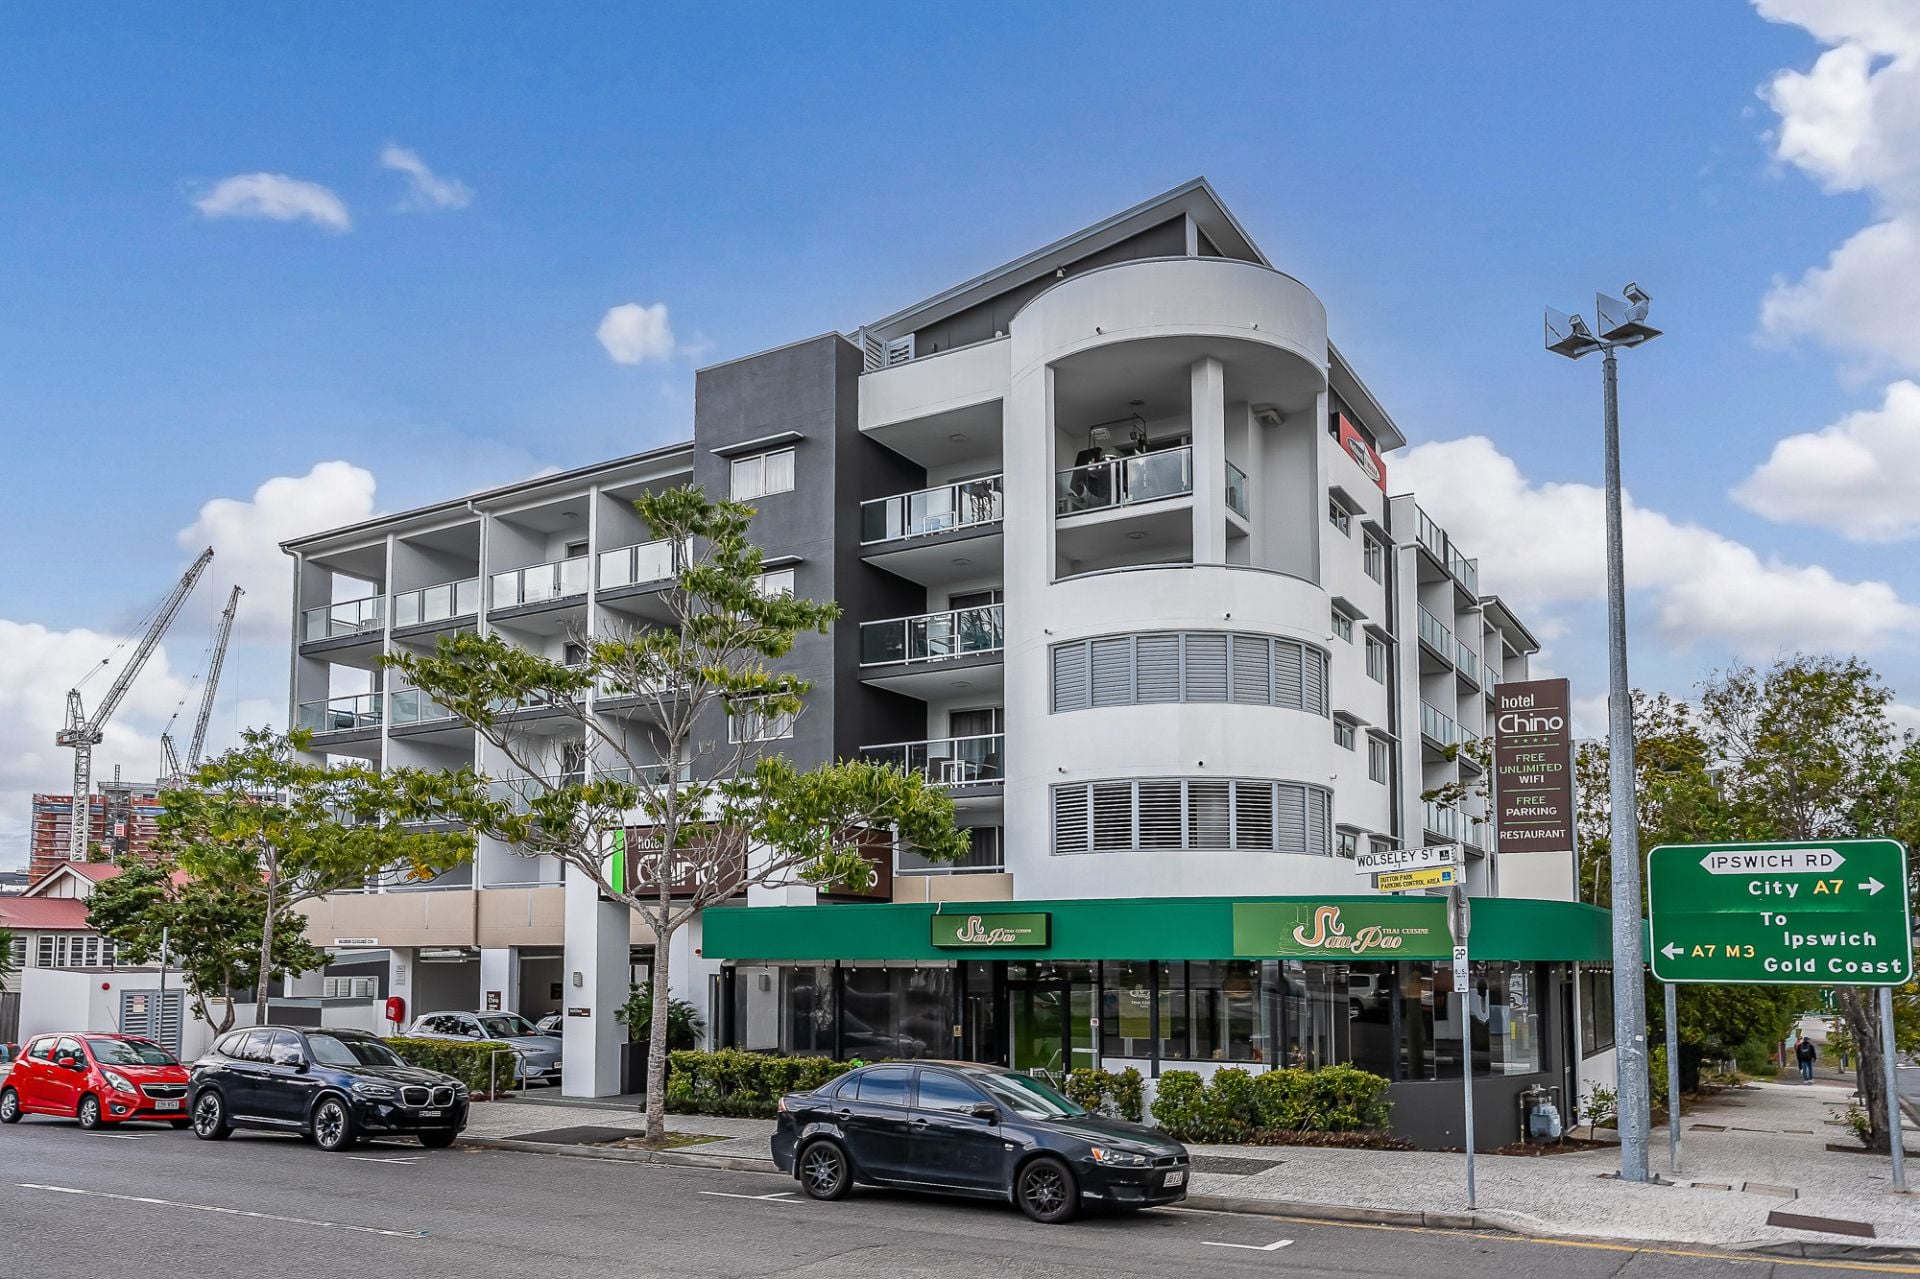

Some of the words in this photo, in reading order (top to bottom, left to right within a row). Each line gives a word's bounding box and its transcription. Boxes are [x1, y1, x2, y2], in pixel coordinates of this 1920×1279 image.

[1501, 693, 1534, 709] hotel
[1498, 712, 1564, 733] Chino
[1515, 752, 1546, 763] FREE
[1499, 763, 1562, 774] UNLIMITED
[1518, 775, 1545, 784] WIFI
[1516, 796, 1546, 806] FREE
[1505, 806, 1557, 817] PARKING
[1500, 829, 1566, 840] RESTAURANT
[1356, 851, 1416, 868] WOLSELEY
[1421, 849, 1433, 860] ST
[1711, 854, 1793, 869] IPSWICH
[1806, 853, 1832, 867] RD
[1403, 880, 1425, 888] CONTROL
[1749, 880, 1799, 898] City
[1813, 879, 1844, 895] A7
[1760, 911, 1787, 926] To
[1784, 931, 1877, 949] Ipswich
[1454, 948, 1466, 960] 2P
[1691, 945, 1716, 957] A7
[1726, 945, 1755, 957] M3
[1764, 957, 1816, 973] Gold
[1828, 958, 1902, 974] Coast
